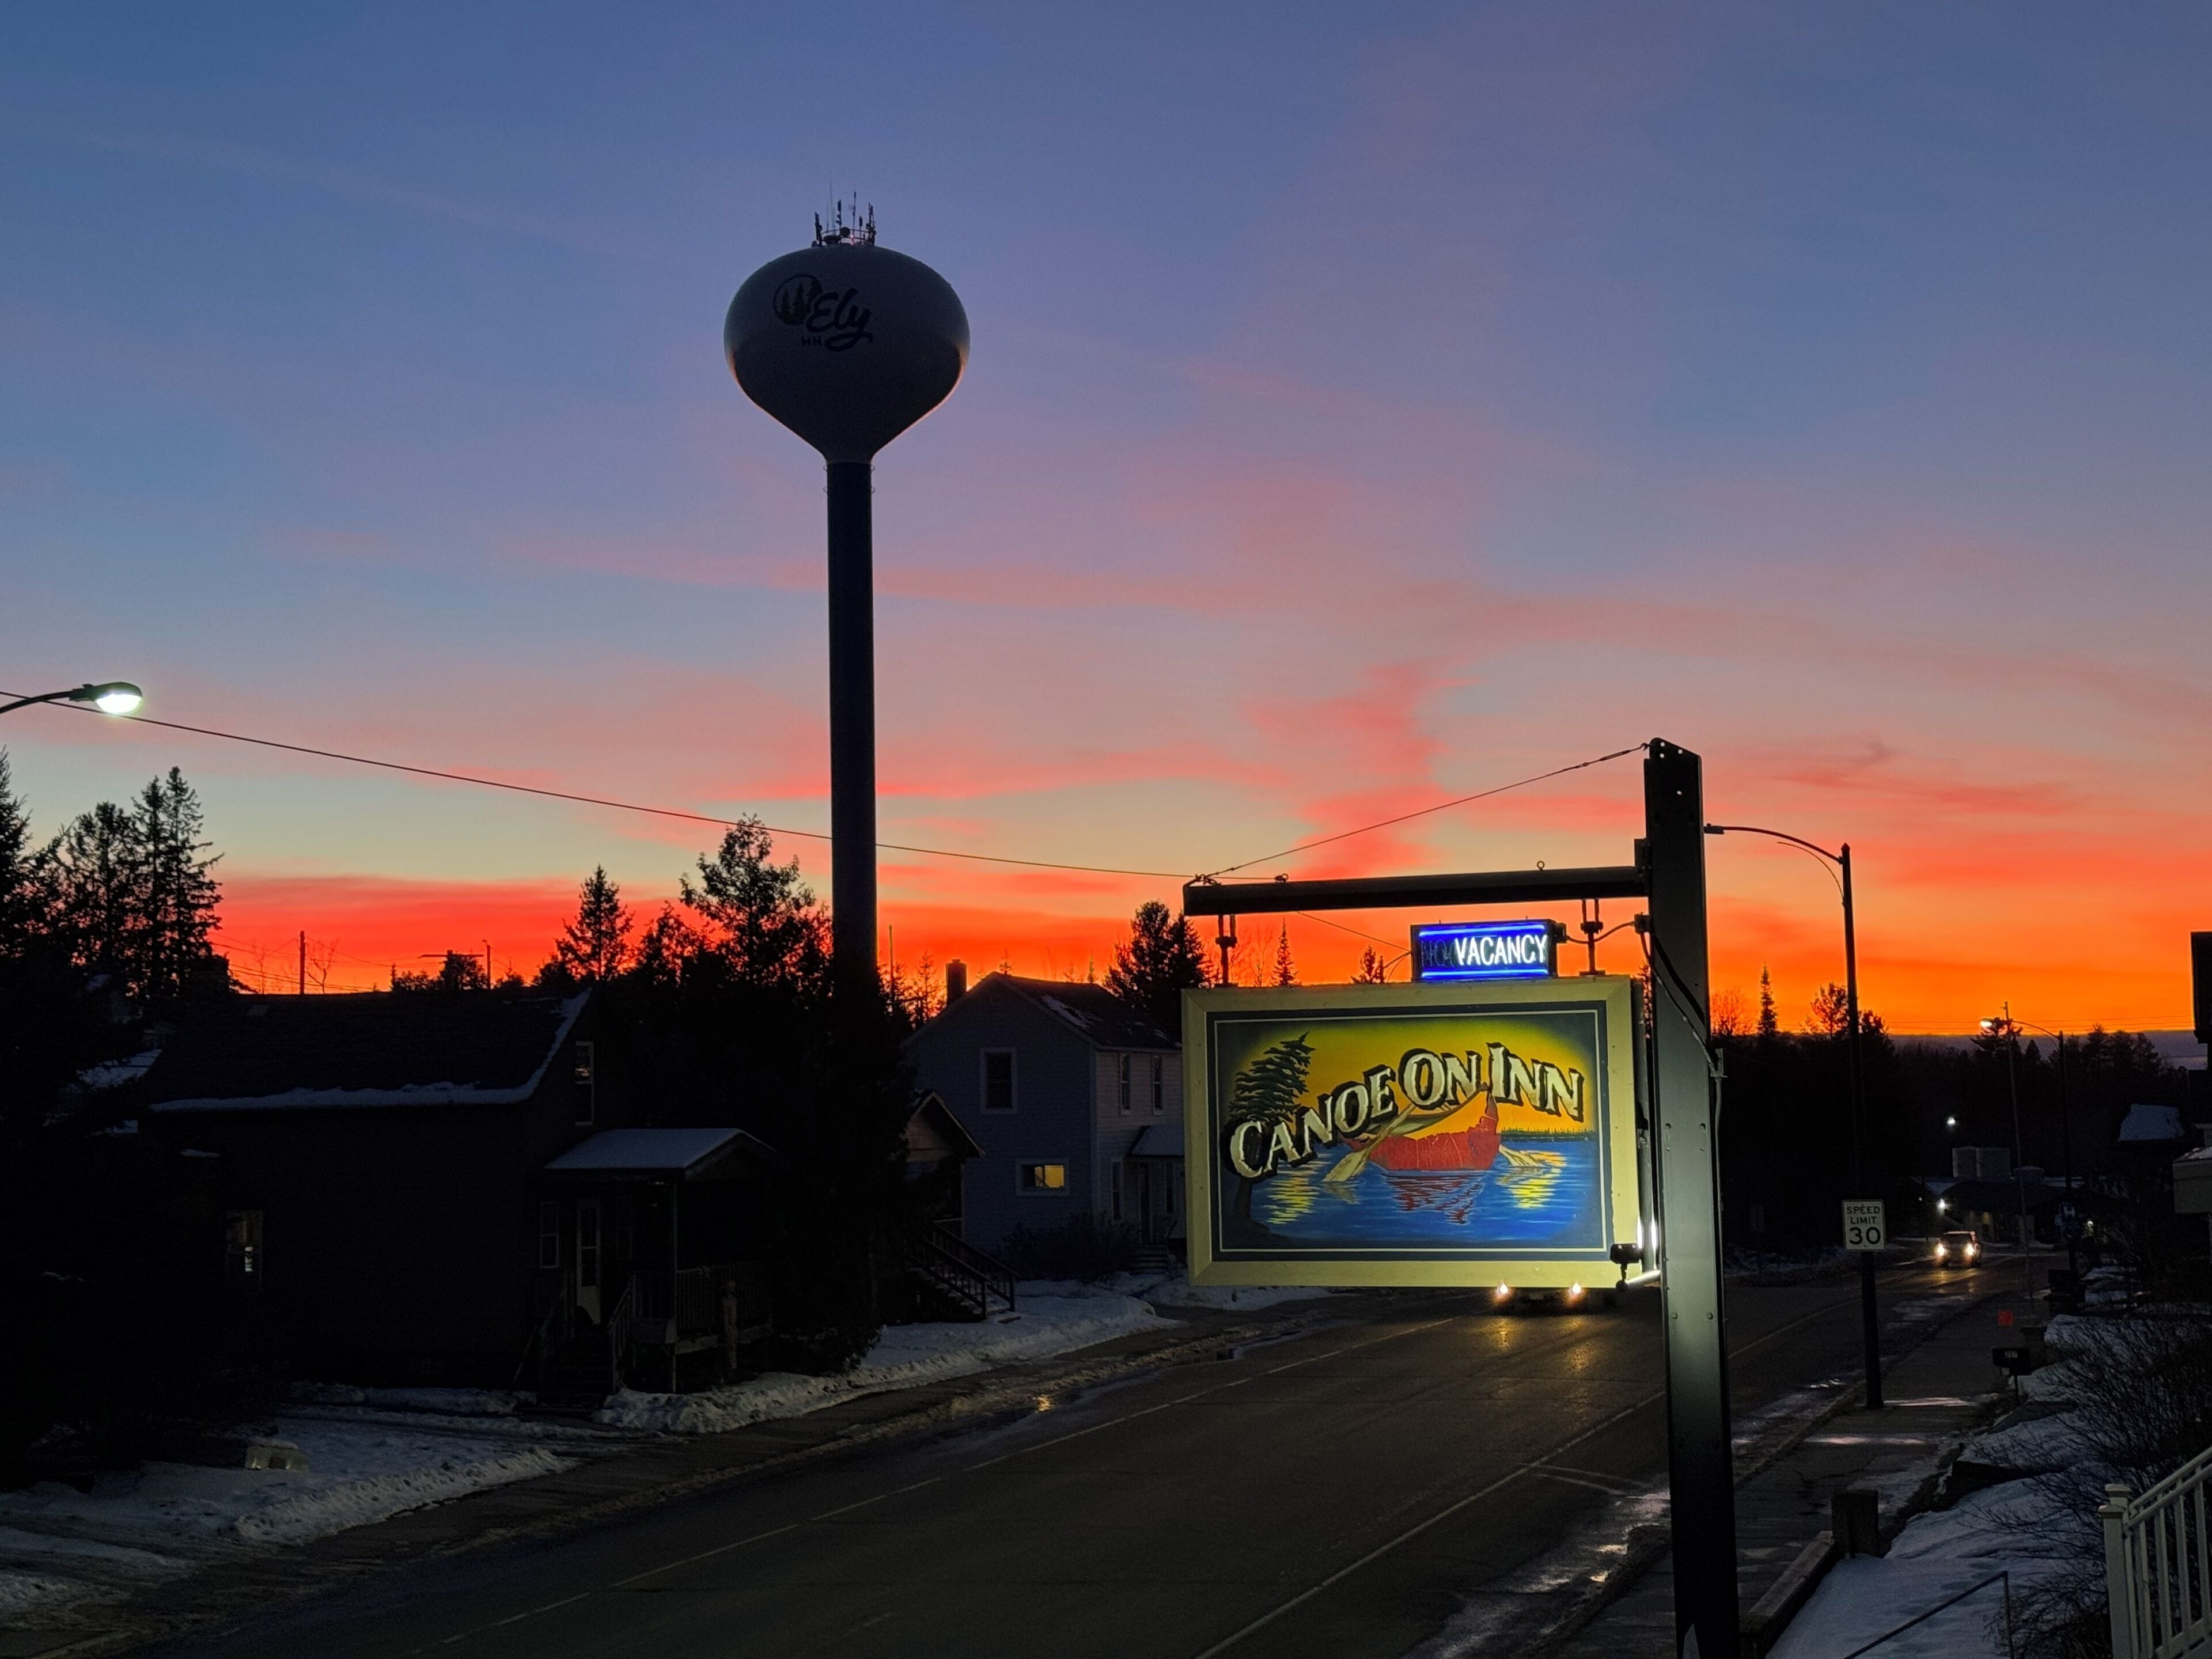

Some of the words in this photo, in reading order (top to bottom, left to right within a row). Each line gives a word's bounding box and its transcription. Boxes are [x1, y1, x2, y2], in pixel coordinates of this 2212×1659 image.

[806, 288, 873, 351] Ely
[1455, 934, 1547, 965] VACANCY
[1224, 1066, 1397, 1178] CANOE
[1400, 1048, 1482, 1109] ON
[1487, 1043, 1584, 1120] INN
[1849, 1227, 1881, 1245] 30
